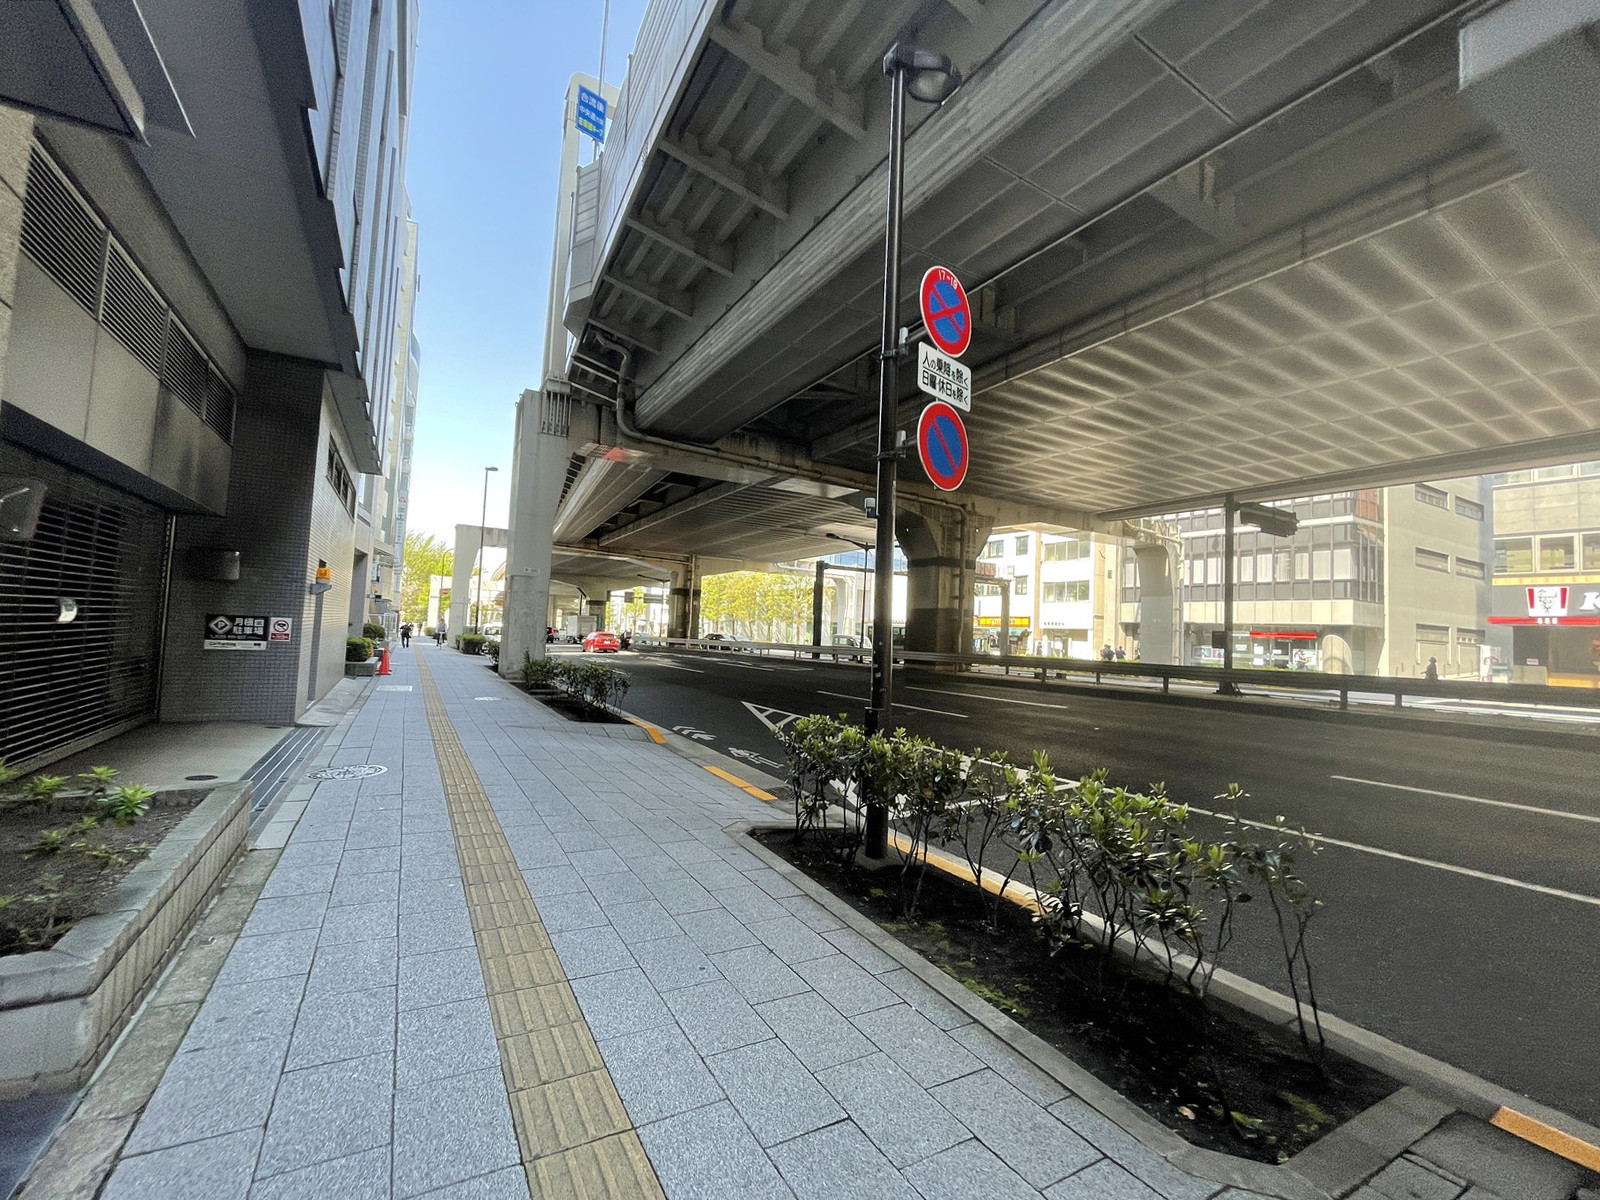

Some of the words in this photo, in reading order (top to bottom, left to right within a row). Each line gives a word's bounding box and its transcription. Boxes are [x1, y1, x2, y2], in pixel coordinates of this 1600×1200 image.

[922, 350, 969, 388] 人の乗降を除く
[232, 626, 264, 636] 駐車場
